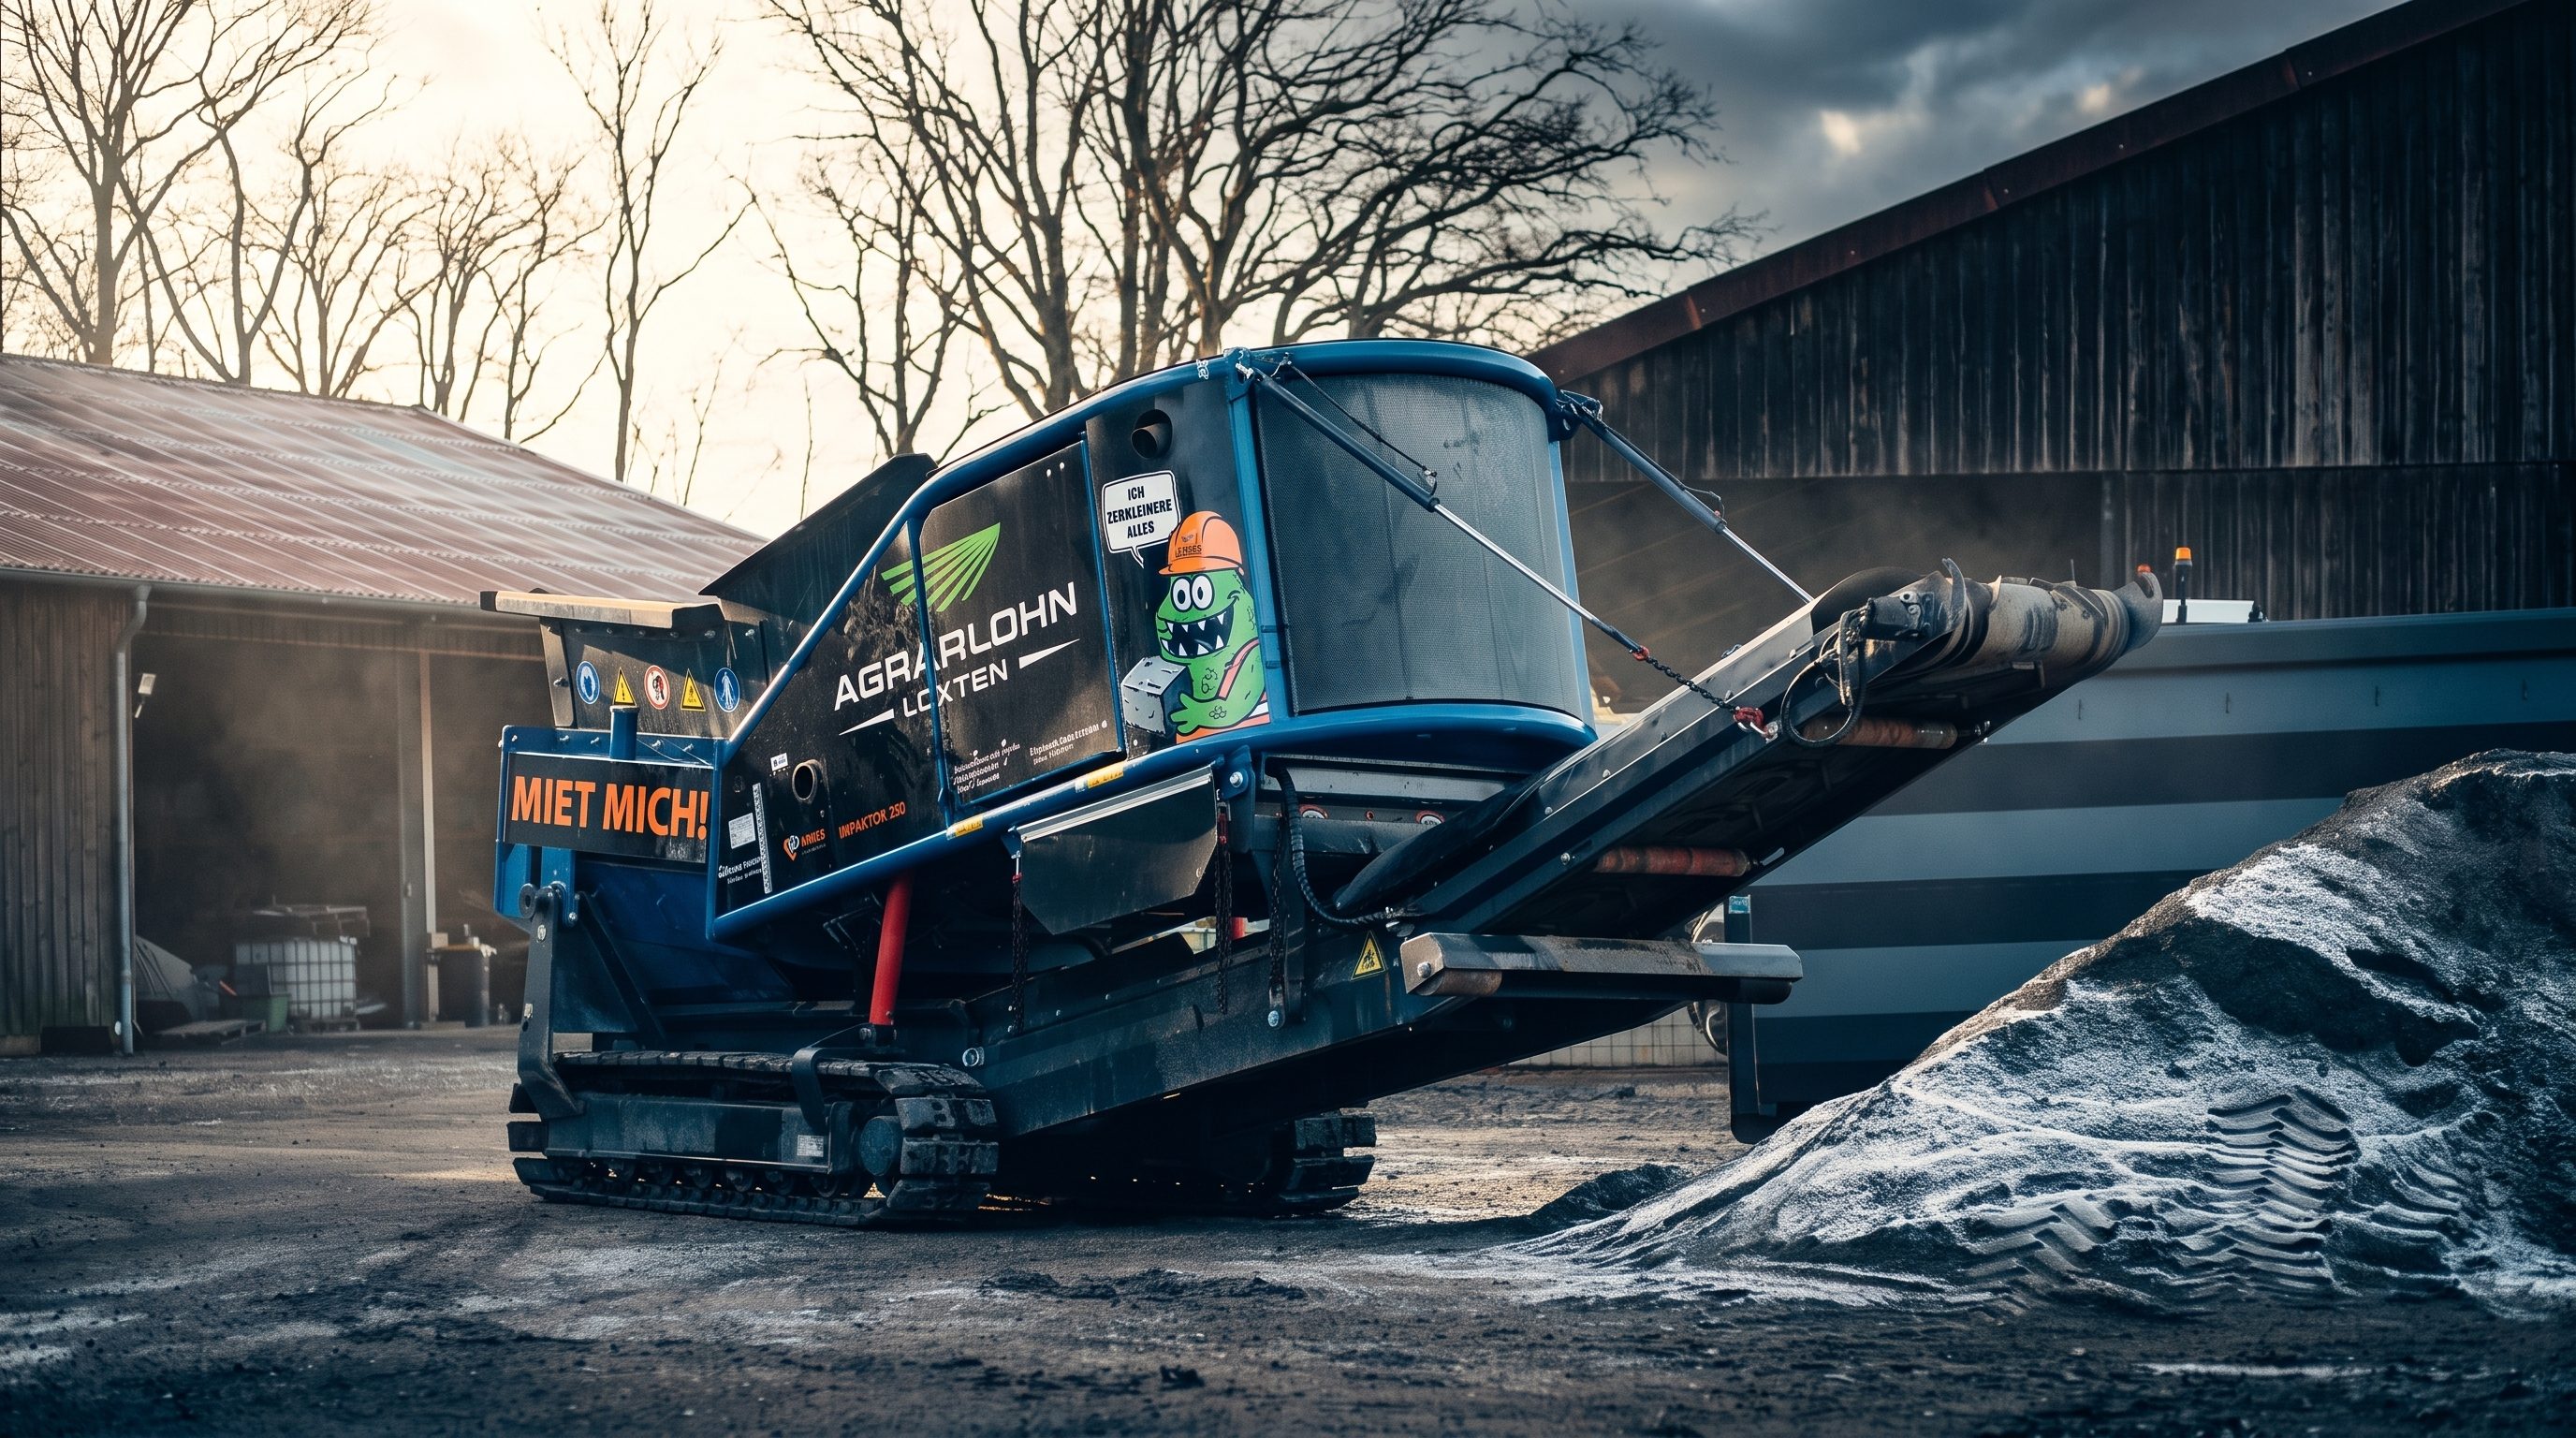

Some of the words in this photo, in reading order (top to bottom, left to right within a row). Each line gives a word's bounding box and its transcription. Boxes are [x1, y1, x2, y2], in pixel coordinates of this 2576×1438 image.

[1106, 498, 1173, 524] ZERKLEINERE
[1128, 485, 1145, 501] ICH
[1127, 521, 1155, 539] ALLES
[834, 581, 1077, 711] AGRARLOHN
[902, 658, 1008, 717] LOXTEN
[511, 775, 596, 829] MIET
[602, 783, 710, 840] MICH!
[838, 809, 887, 839] IMPAKTOR
[889, 801, 906, 820] 250
